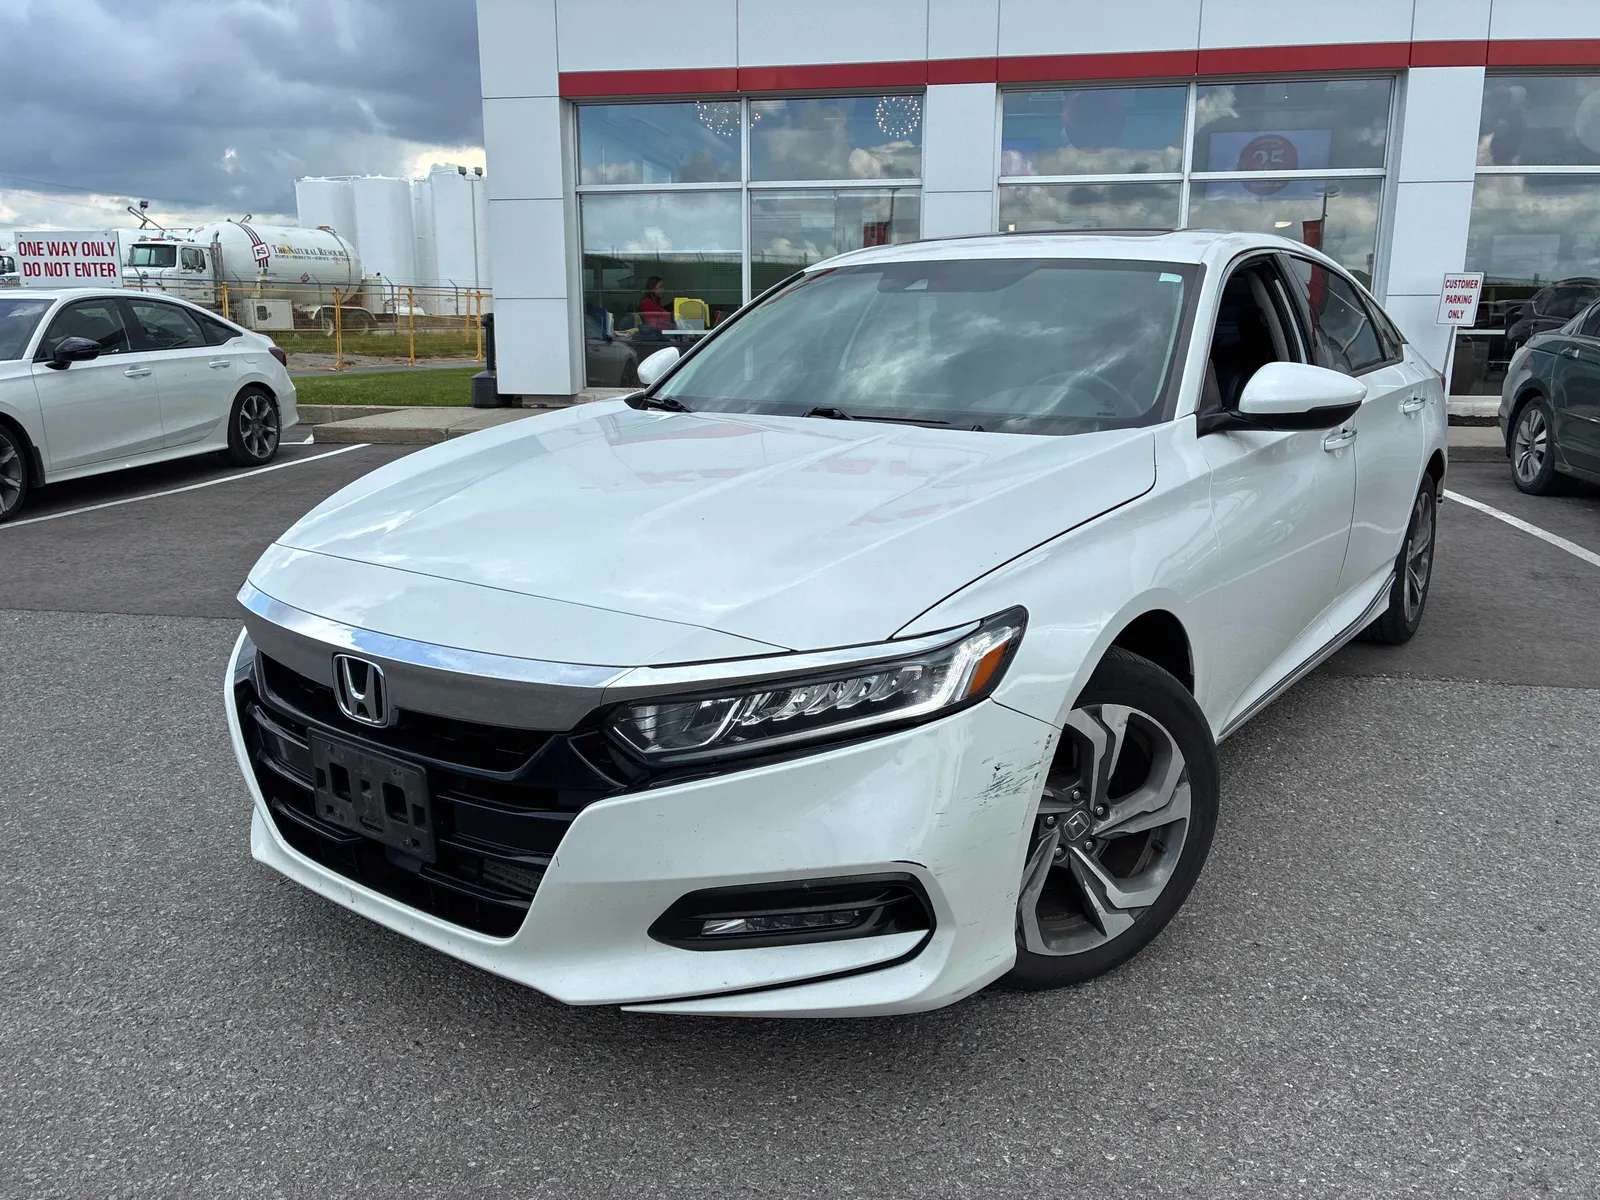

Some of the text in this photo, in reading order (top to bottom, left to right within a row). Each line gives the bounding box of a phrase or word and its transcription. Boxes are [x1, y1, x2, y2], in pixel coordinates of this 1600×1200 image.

[18, 241, 116, 257] ONE WAY ONLY
[287, 245, 318, 256] NATURAL
[22, 262, 117, 277] DO NOT ENTER
[1445, 279, 1479, 289] CUSTOMER
[1445, 294, 1473, 304] PARKING
[1447, 309, 1465, 319] ONLY
